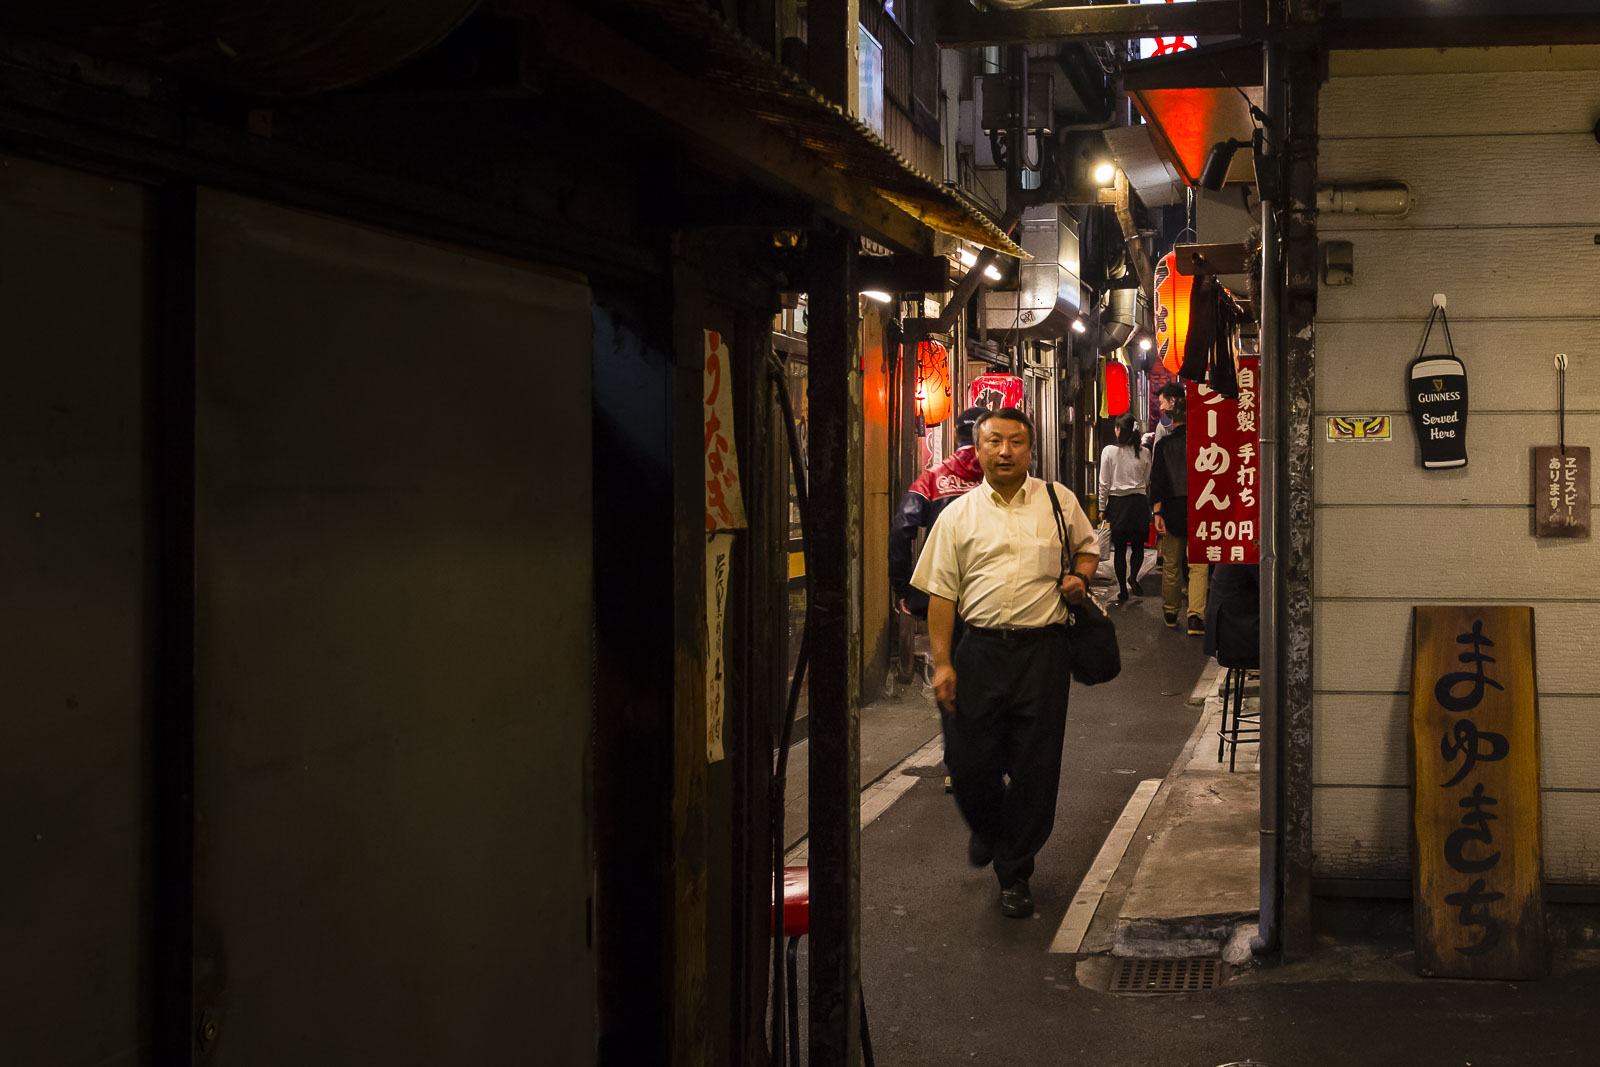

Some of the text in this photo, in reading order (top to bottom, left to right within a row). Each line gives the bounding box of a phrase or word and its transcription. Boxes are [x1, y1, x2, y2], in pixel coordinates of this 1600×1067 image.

[1417, 391, 1461, 404] GUINNESS
[1422, 410, 1460, 425] Served
[1236, 367, 1257, 508] 自家製 手打ち
[1430, 427, 1456, 441] Here
[1195, 520, 1254, 541] 450円
[1205, 545, 1245, 562] 若月
[1434, 620, 1510, 957] まゆきち
